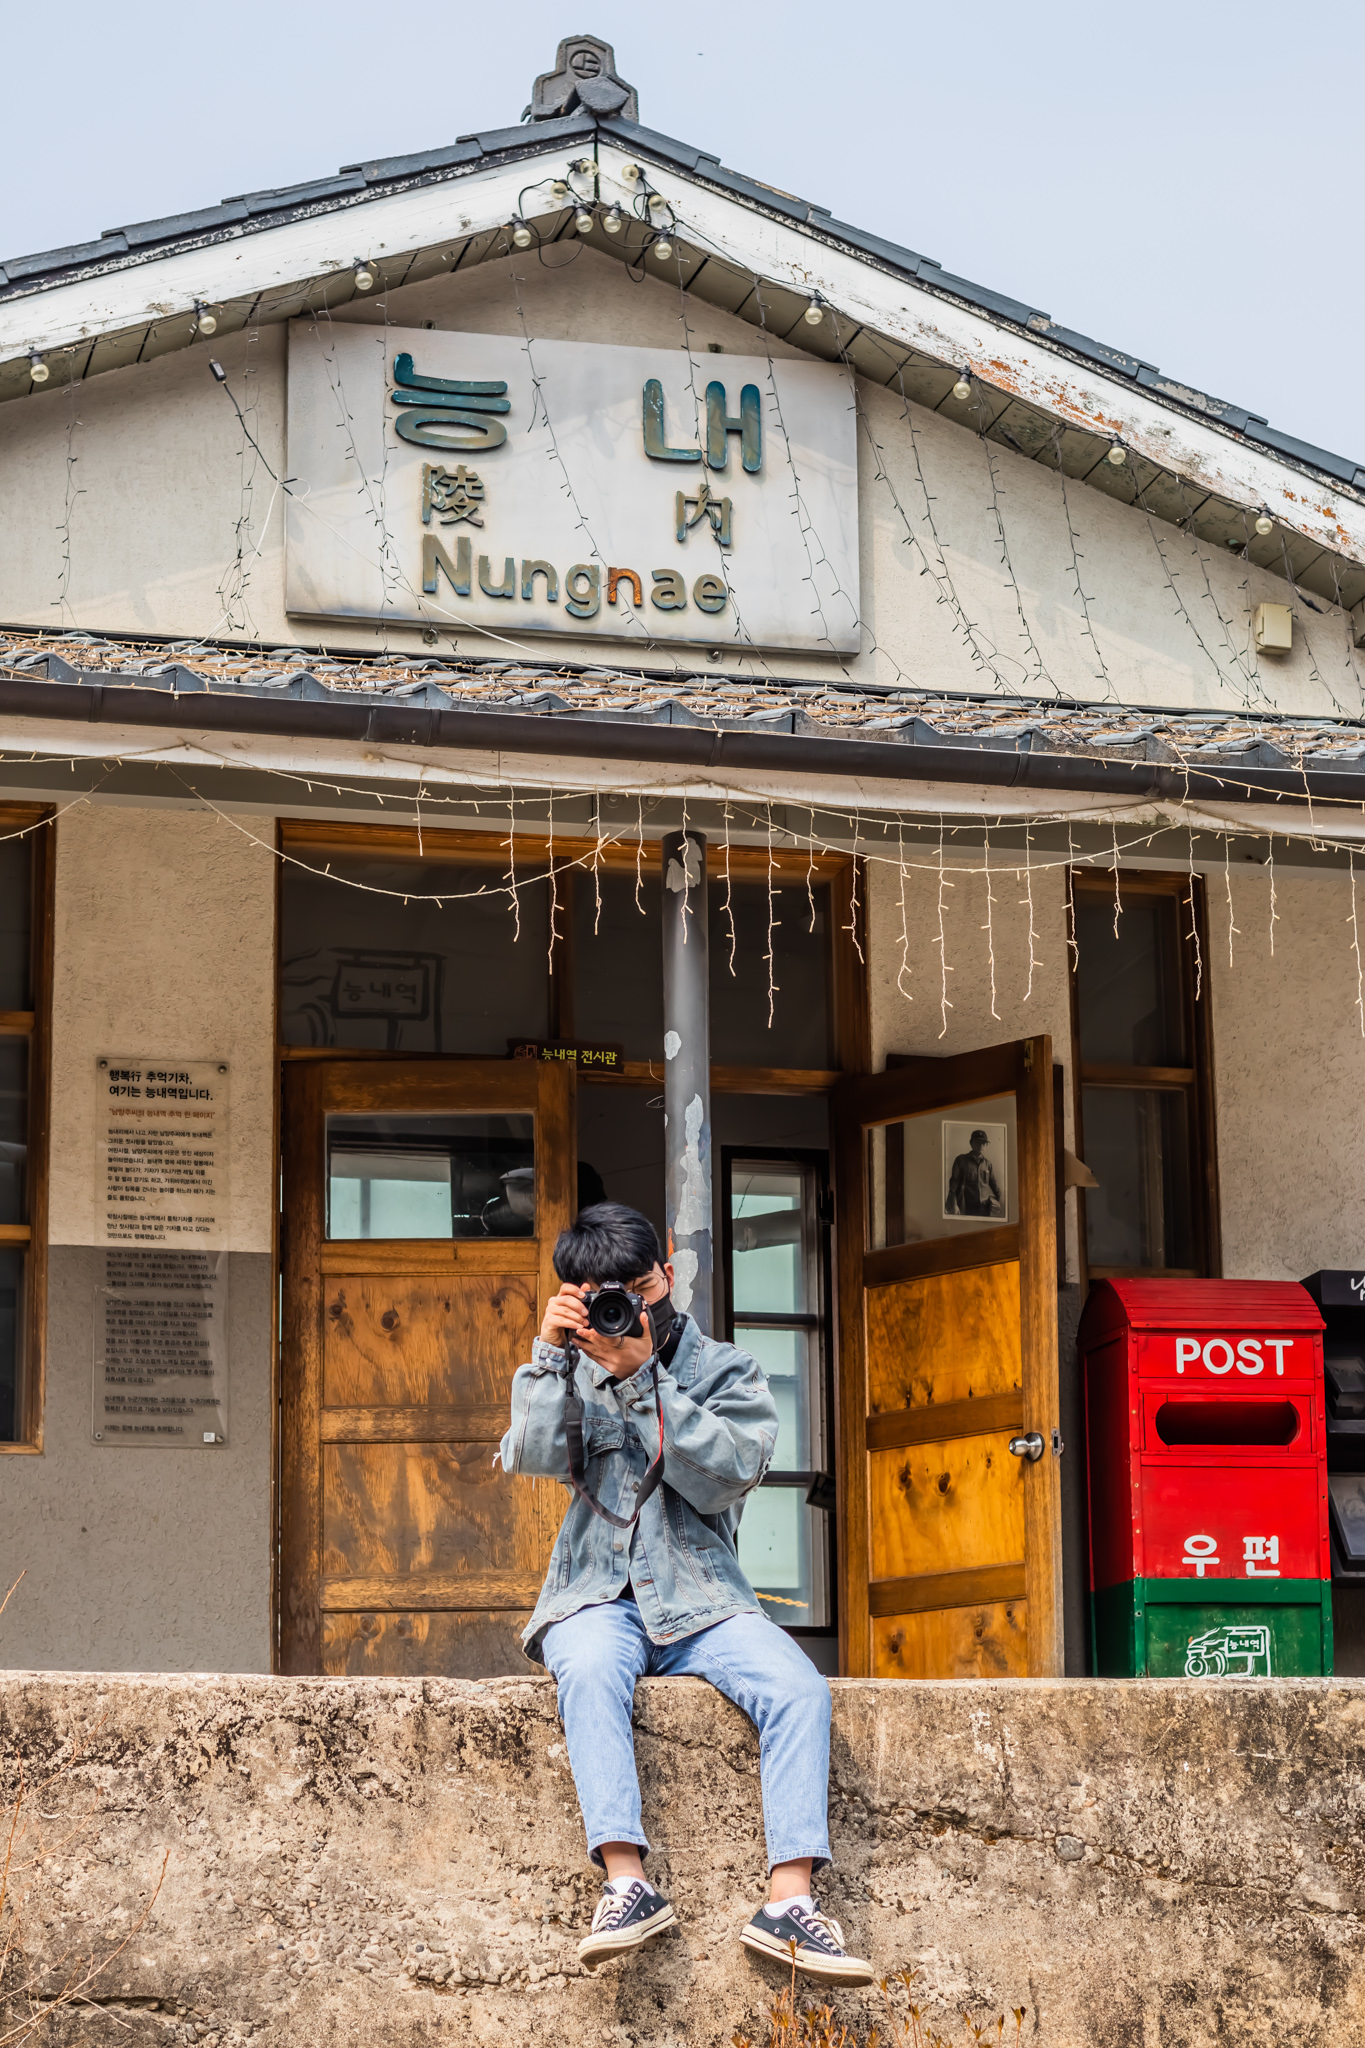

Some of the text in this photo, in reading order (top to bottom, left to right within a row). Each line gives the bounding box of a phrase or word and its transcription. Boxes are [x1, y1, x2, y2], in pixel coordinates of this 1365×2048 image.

[422, 534, 728, 618] Nungnae
[342, 981, 417, 1006] 능내역
[541, 1048, 617, 1065] 능내역 전시관
[109, 1086, 213, 1101] 여기는 능내역입니다.
[146, 1109, 167, 1118] 능내역
[1175, 1338, 1294, 1375] POST
[1229, 1639, 1260, 1650] 능내역
